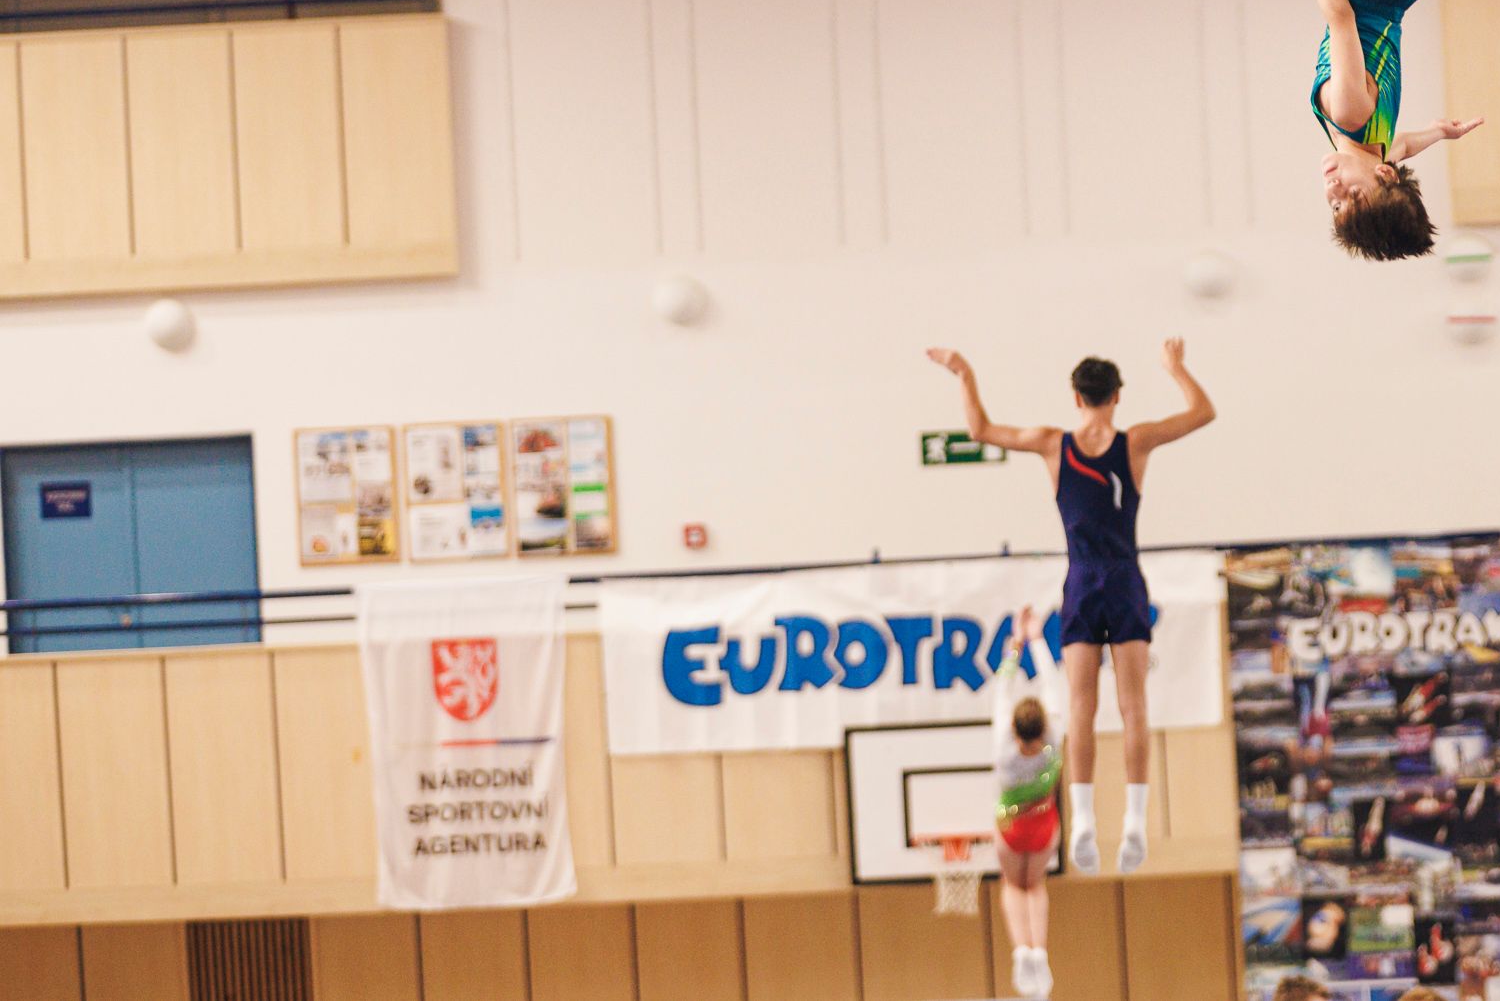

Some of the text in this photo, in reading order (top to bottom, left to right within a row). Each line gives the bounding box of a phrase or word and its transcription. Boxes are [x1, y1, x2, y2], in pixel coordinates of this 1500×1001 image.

[662, 603, 1159, 706] EUROTRA
[407, 795, 550, 825] SPORTOVNÍ
[414, 832, 547, 858] AGENTURA
